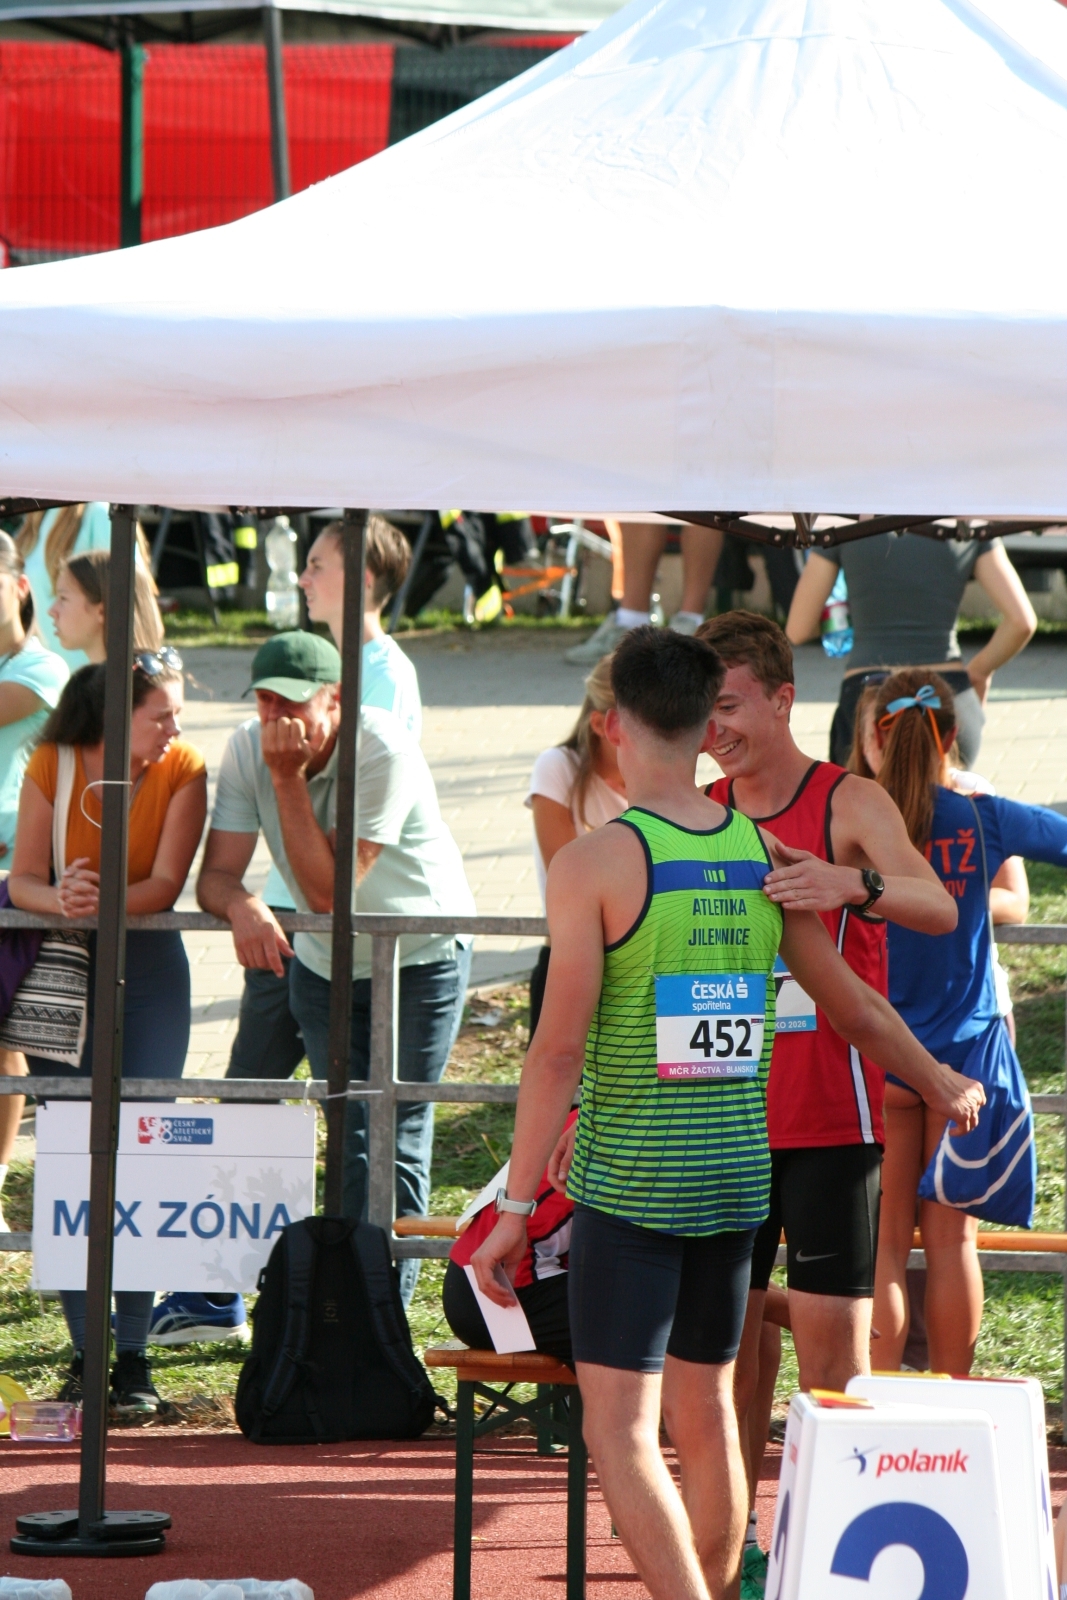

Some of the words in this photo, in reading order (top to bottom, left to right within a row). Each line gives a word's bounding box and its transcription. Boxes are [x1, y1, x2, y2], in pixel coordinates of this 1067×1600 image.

[944, 878, 967, 897] OV
[692, 897, 748, 916] ATLETIKA
[688, 927, 751, 946] JILEMNICE
[691, 980, 735, 1000] ČESKÁ
[692, 1001, 732, 1013] spořitelna
[788, 1020, 807, 1029] 2026
[689, 1018, 753, 1058] 452
[669, 1066, 690, 1076] MČR
[691, 1065, 722, 1075] ŽACTVA
[726, 1065, 754, 1074] BLANSKO
[53, 1199, 143, 1238] MX
[156, 1194, 293, 1240] ZÓNA
[876, 1447, 969, 1479] polanik
